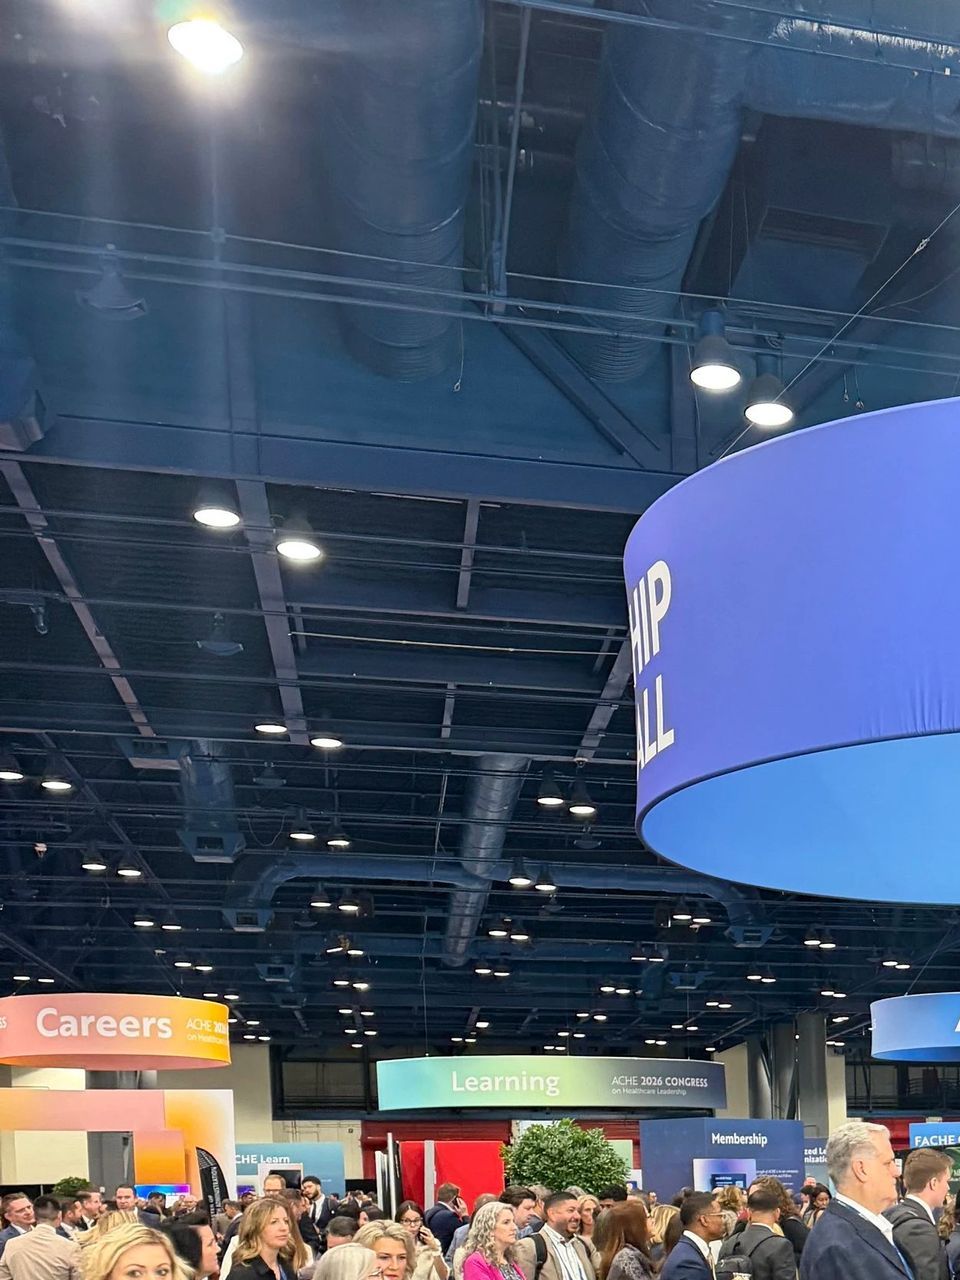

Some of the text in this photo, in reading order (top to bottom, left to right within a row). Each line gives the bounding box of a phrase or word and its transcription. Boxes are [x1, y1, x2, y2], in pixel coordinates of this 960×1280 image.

[36, 1007, 173, 1038] Careers
[185, 1018, 212, 1032] ACHE
[451, 1070, 560, 1096] Learning
[611, 1076, 708, 1088] ACHE 2026 CONGRESS
[657, 1088, 687, 1097] Leadership
[711, 1133, 768, 1148] Membership
[914, 1135, 955, 1146] FACHE
[804, 1147, 817, 1155] zed
[260, 1154, 290, 1164] Learn
